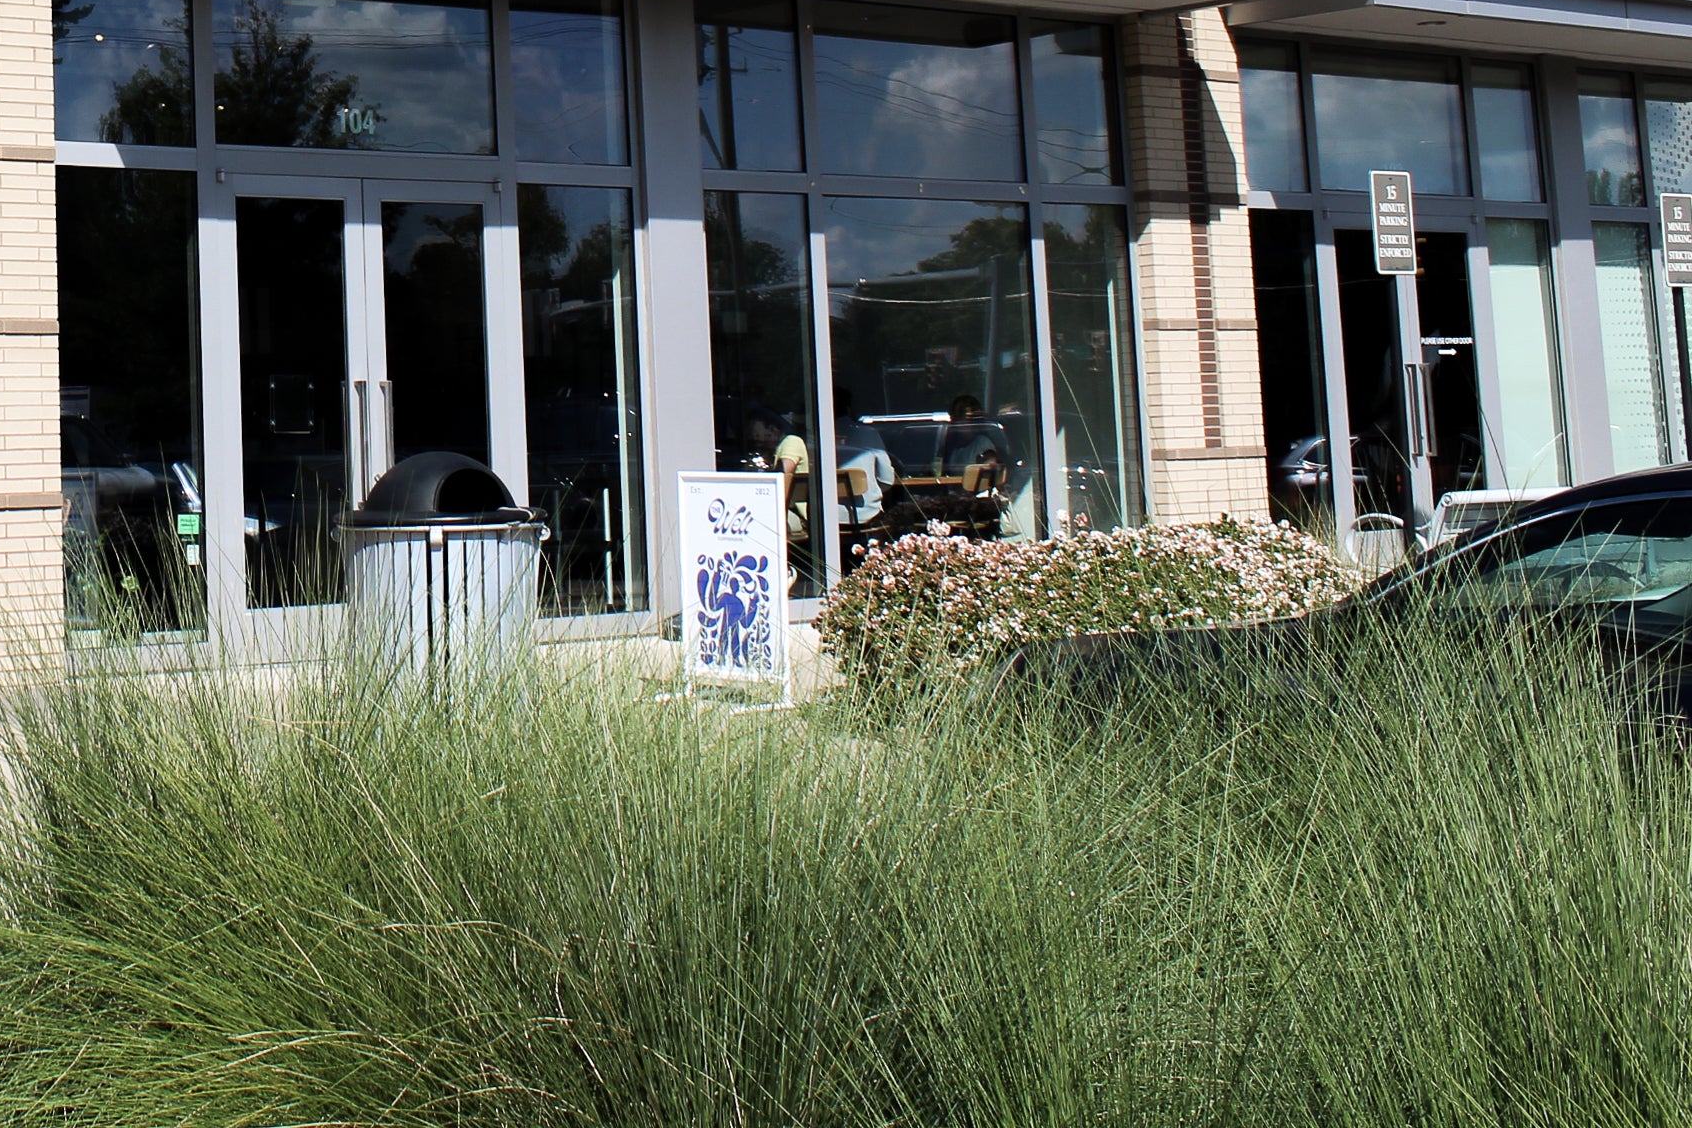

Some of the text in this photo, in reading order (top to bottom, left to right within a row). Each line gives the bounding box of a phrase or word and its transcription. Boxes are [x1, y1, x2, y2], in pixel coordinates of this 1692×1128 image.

[337, 107, 376, 134] 104
[1386, 185, 1397, 200] 15
[1379, 203, 1406, 213] MINUTE
[1673, 207, 1682, 219] 15
[1379, 216, 1408, 226] PARKING
[1667, 222, 1691, 232] MINUTE
[1379, 235, 1409, 244] STRICTLY
[1379, 248, 1412, 258] ENFORCED
[1668, 262, 1692, 272] ENFORCE
[708, 498, 754, 535] Well
